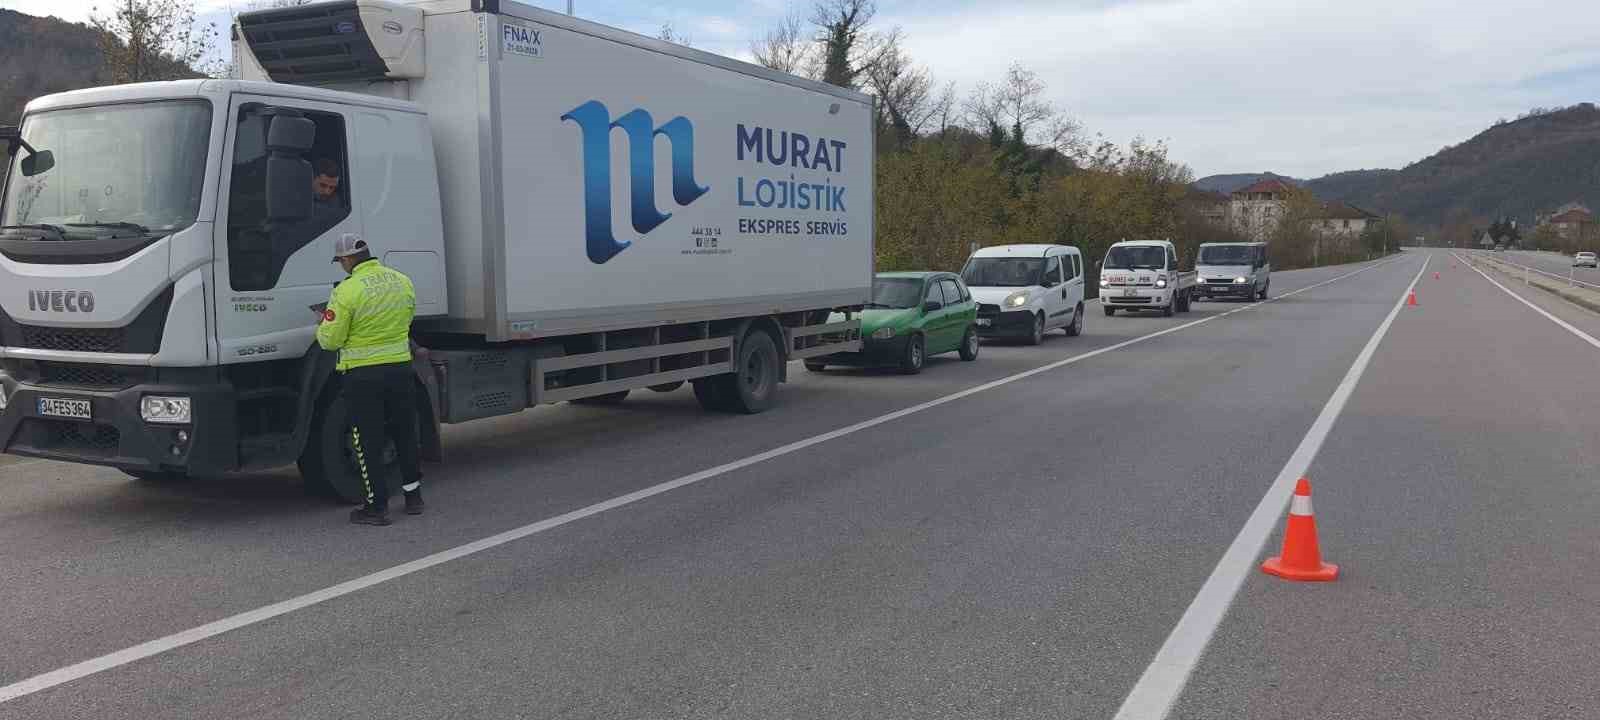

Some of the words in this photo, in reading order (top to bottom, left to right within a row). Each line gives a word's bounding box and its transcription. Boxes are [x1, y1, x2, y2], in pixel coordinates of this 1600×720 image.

[504, 25, 540, 45] FNA/X
[736, 123, 846, 173] MURAT
[737, 173, 846, 212] LOJİSTİK
[738, 218, 801, 235] EKSPRES
[806, 219, 848, 236] SERVİS
[28, 290, 95, 313] IVECO
